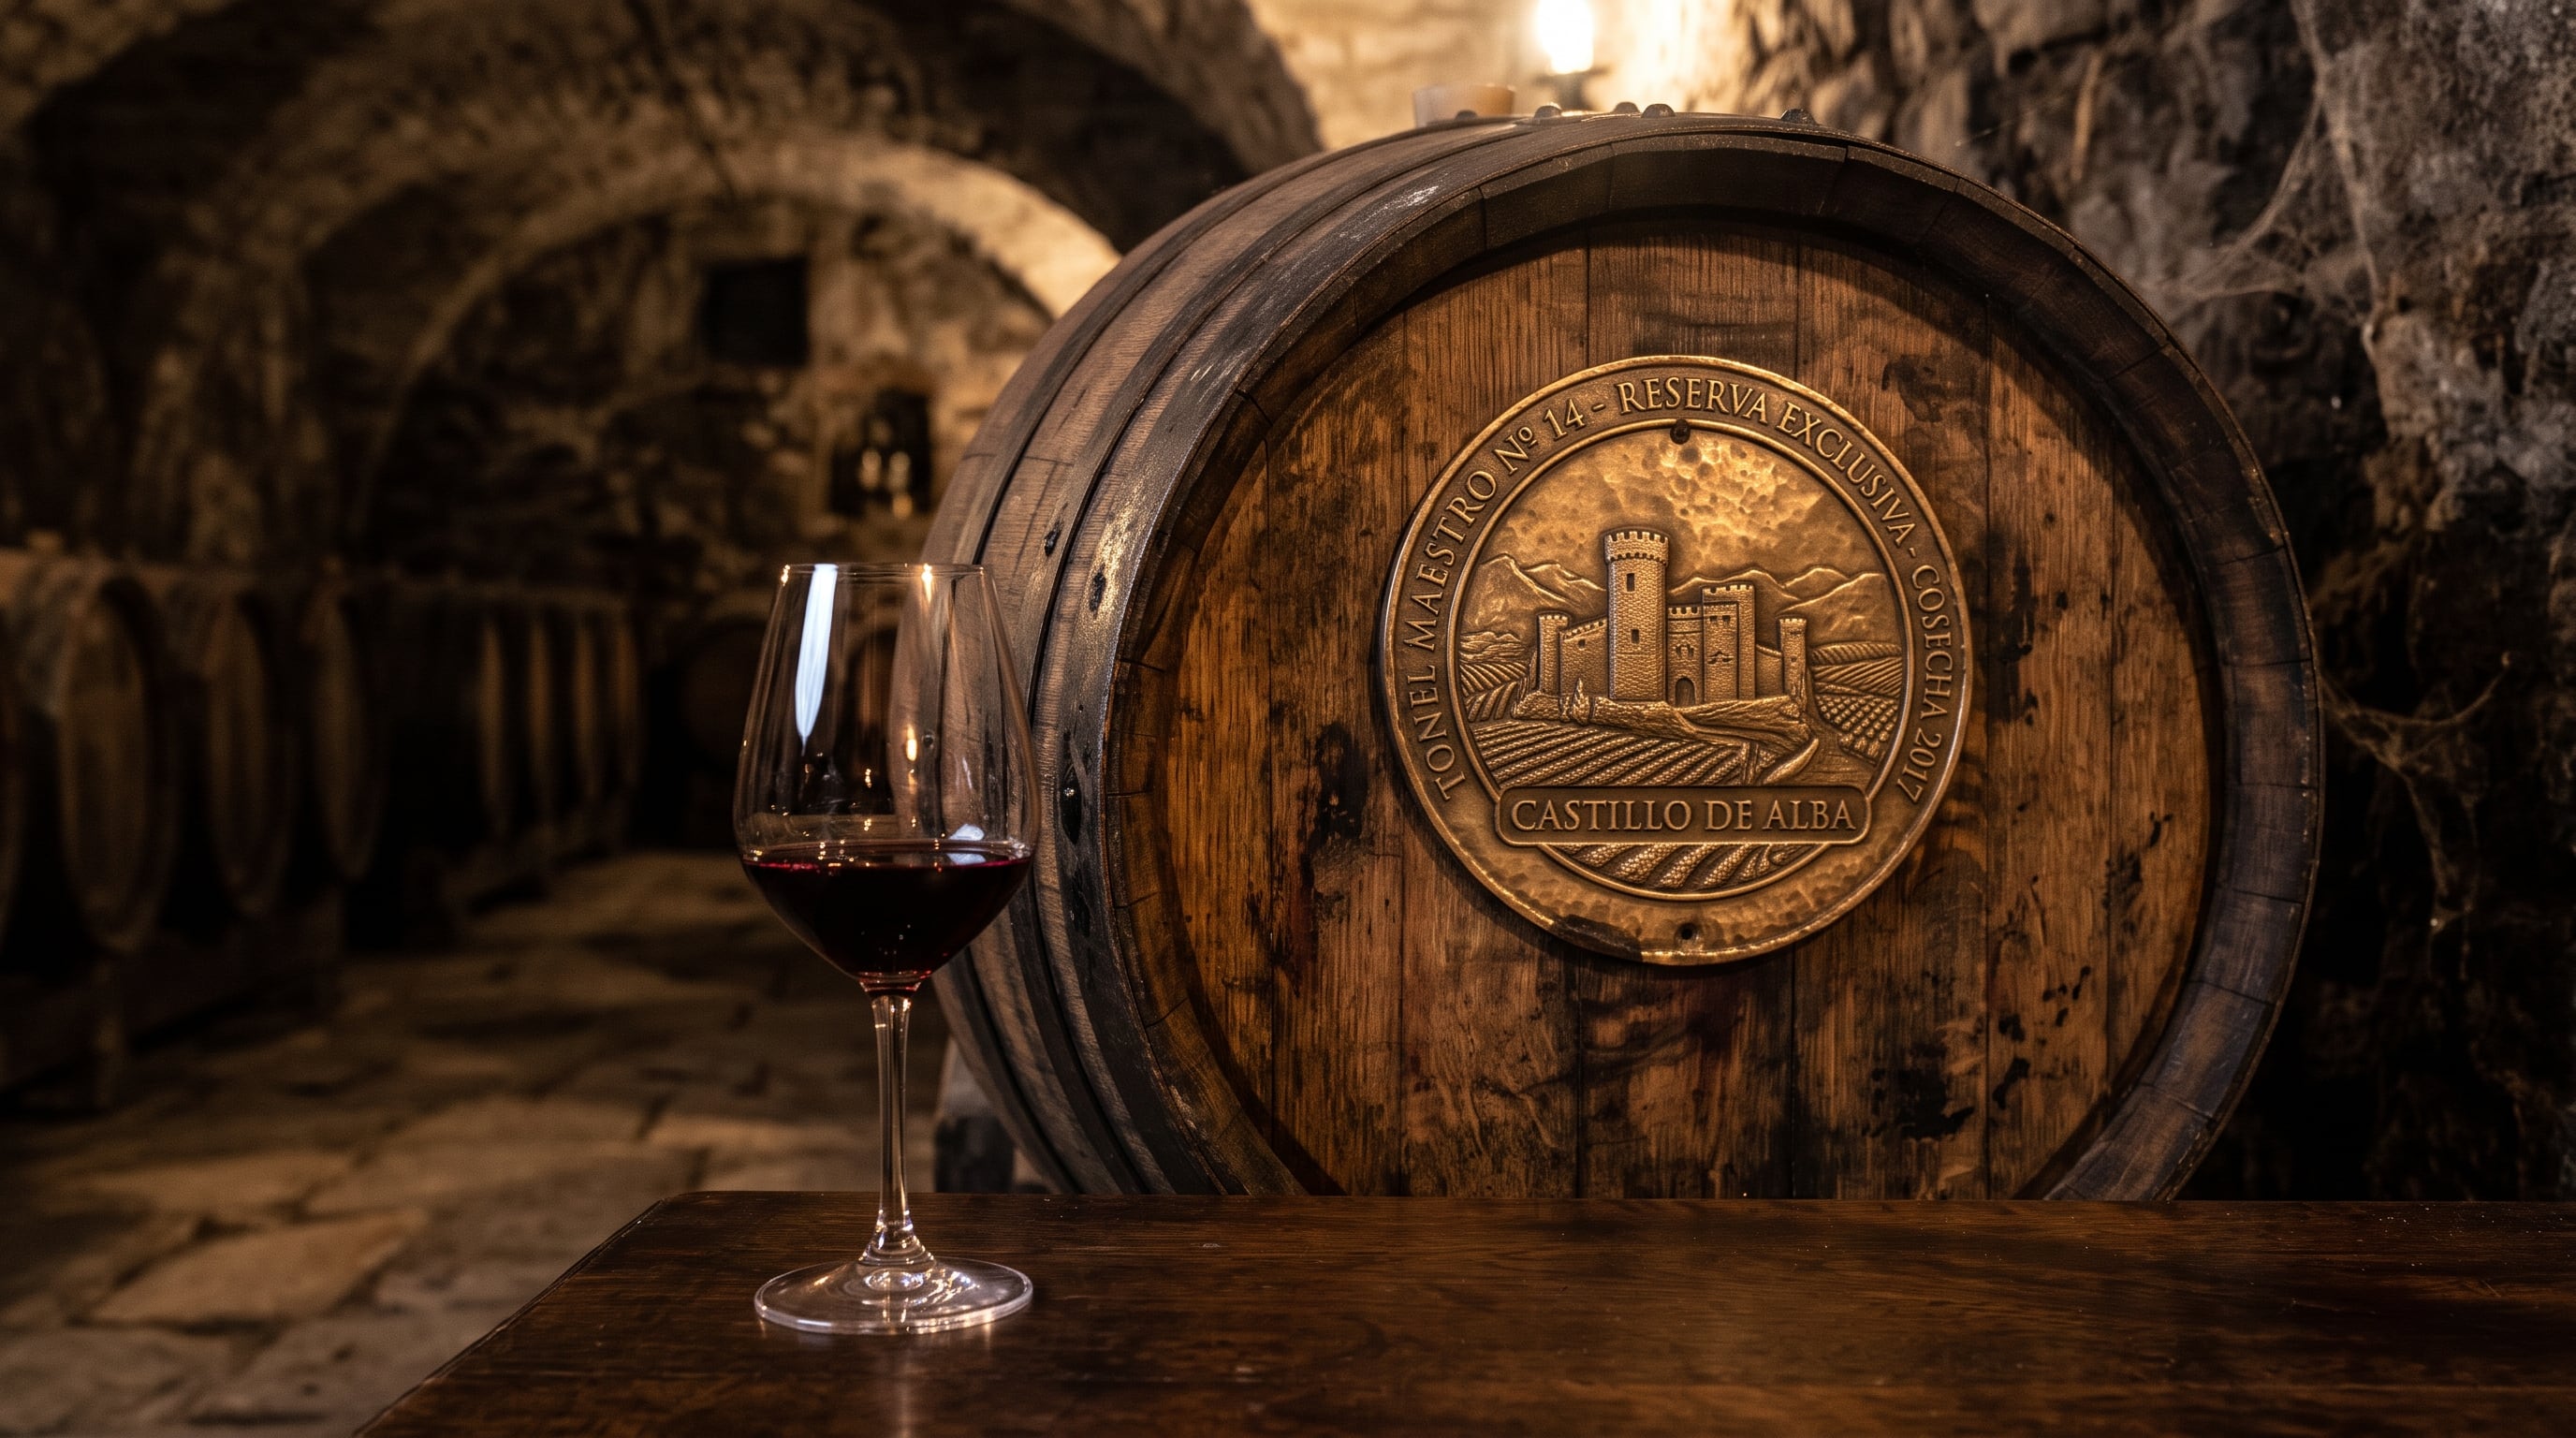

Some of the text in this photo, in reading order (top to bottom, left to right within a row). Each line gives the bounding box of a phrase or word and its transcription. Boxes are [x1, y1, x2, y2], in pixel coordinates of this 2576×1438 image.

[1544, 398, 1585, 440] 14
[1617, 376, 1769, 424] RESERVA
[1778, 402, 1916, 547] EXCLUSIVA
[1404, 470, 1498, 651] MAESTRO
[1911, 564, 1953, 720] COSECHA
[1407, 665, 1465, 800] TONEL
[1896, 727, 1942, 803] 2017
[1510, 800, 1857, 831] CASTILLO DE ALBA
